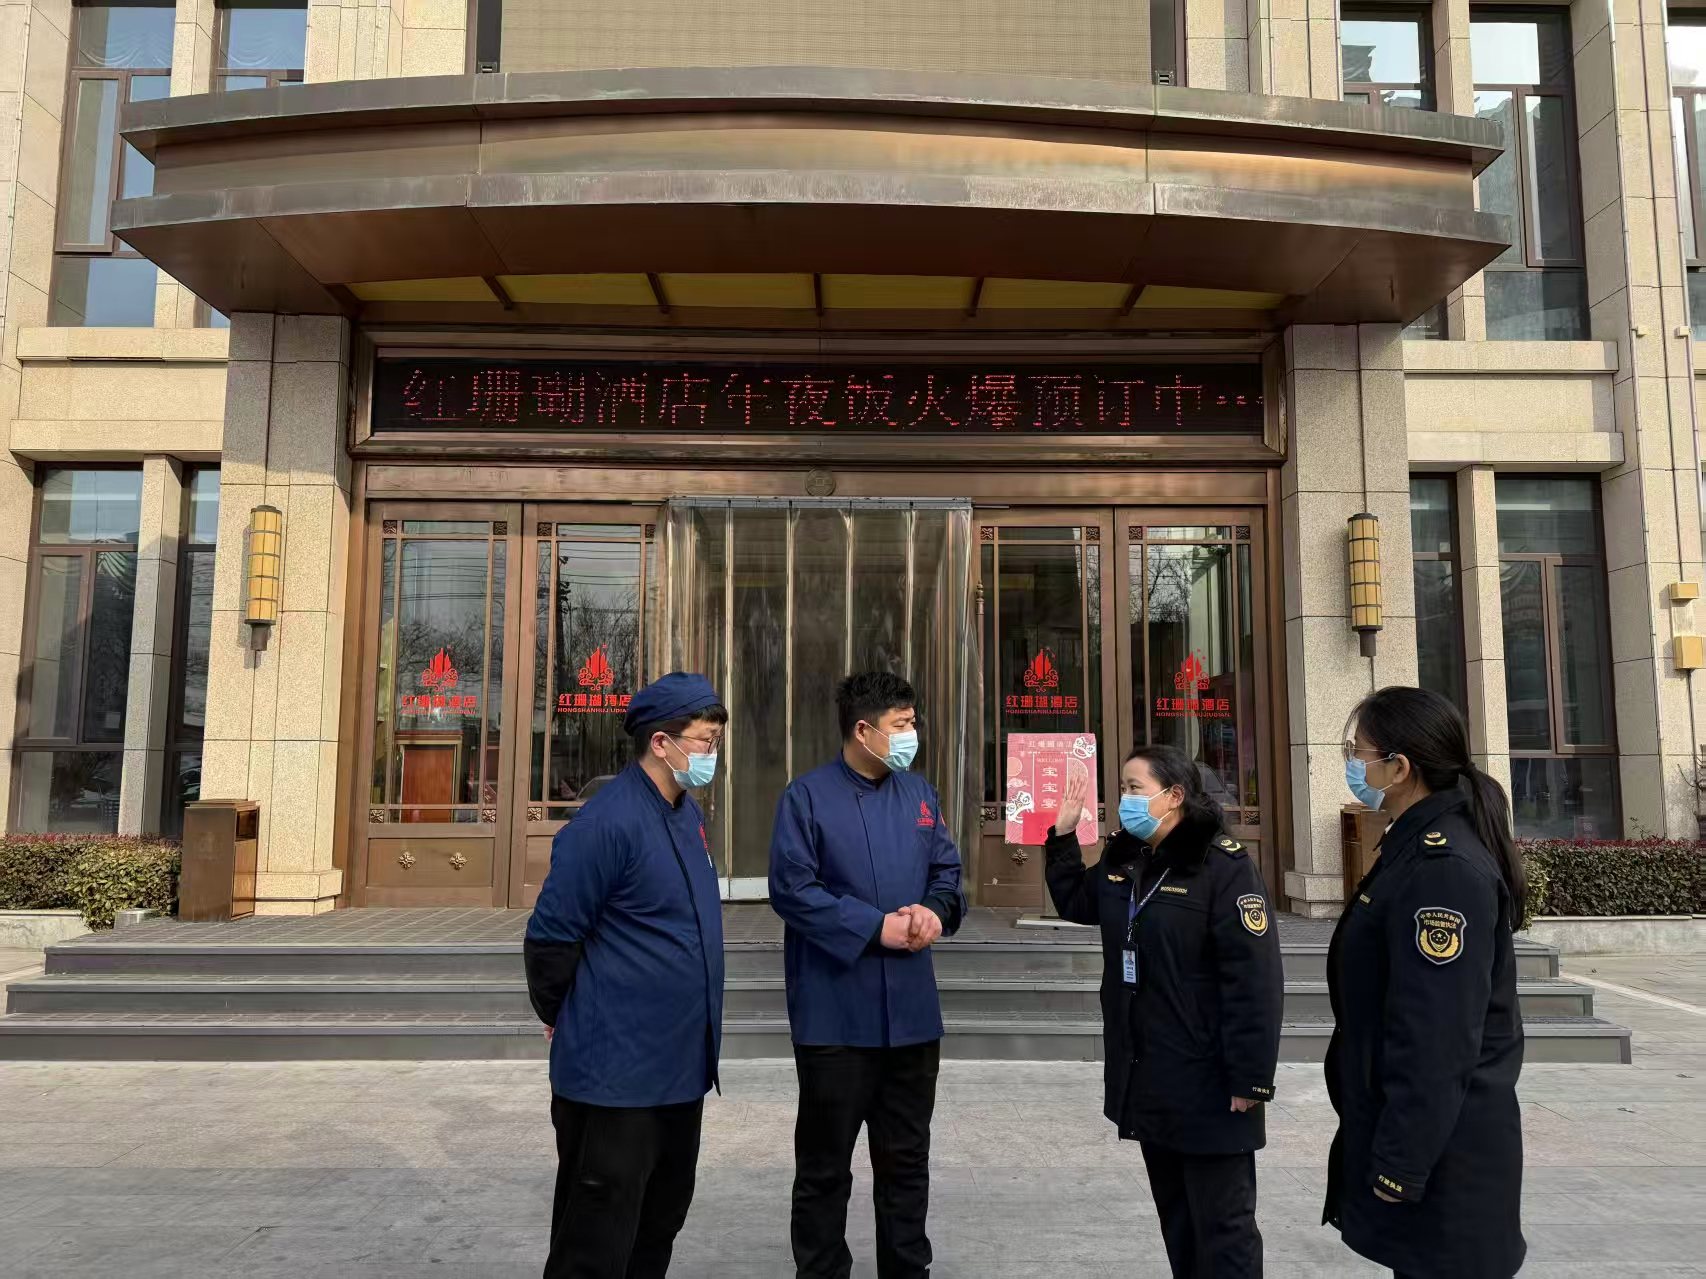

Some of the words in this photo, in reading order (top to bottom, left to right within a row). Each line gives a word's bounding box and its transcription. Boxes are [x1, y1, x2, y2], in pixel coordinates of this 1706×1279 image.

[558, 693, 633, 707] 红珊瑚酒店
[1005, 695, 1078, 708] 红珊瑚酒店
[1156, 697, 1230, 711] 红珊瑚酒店
